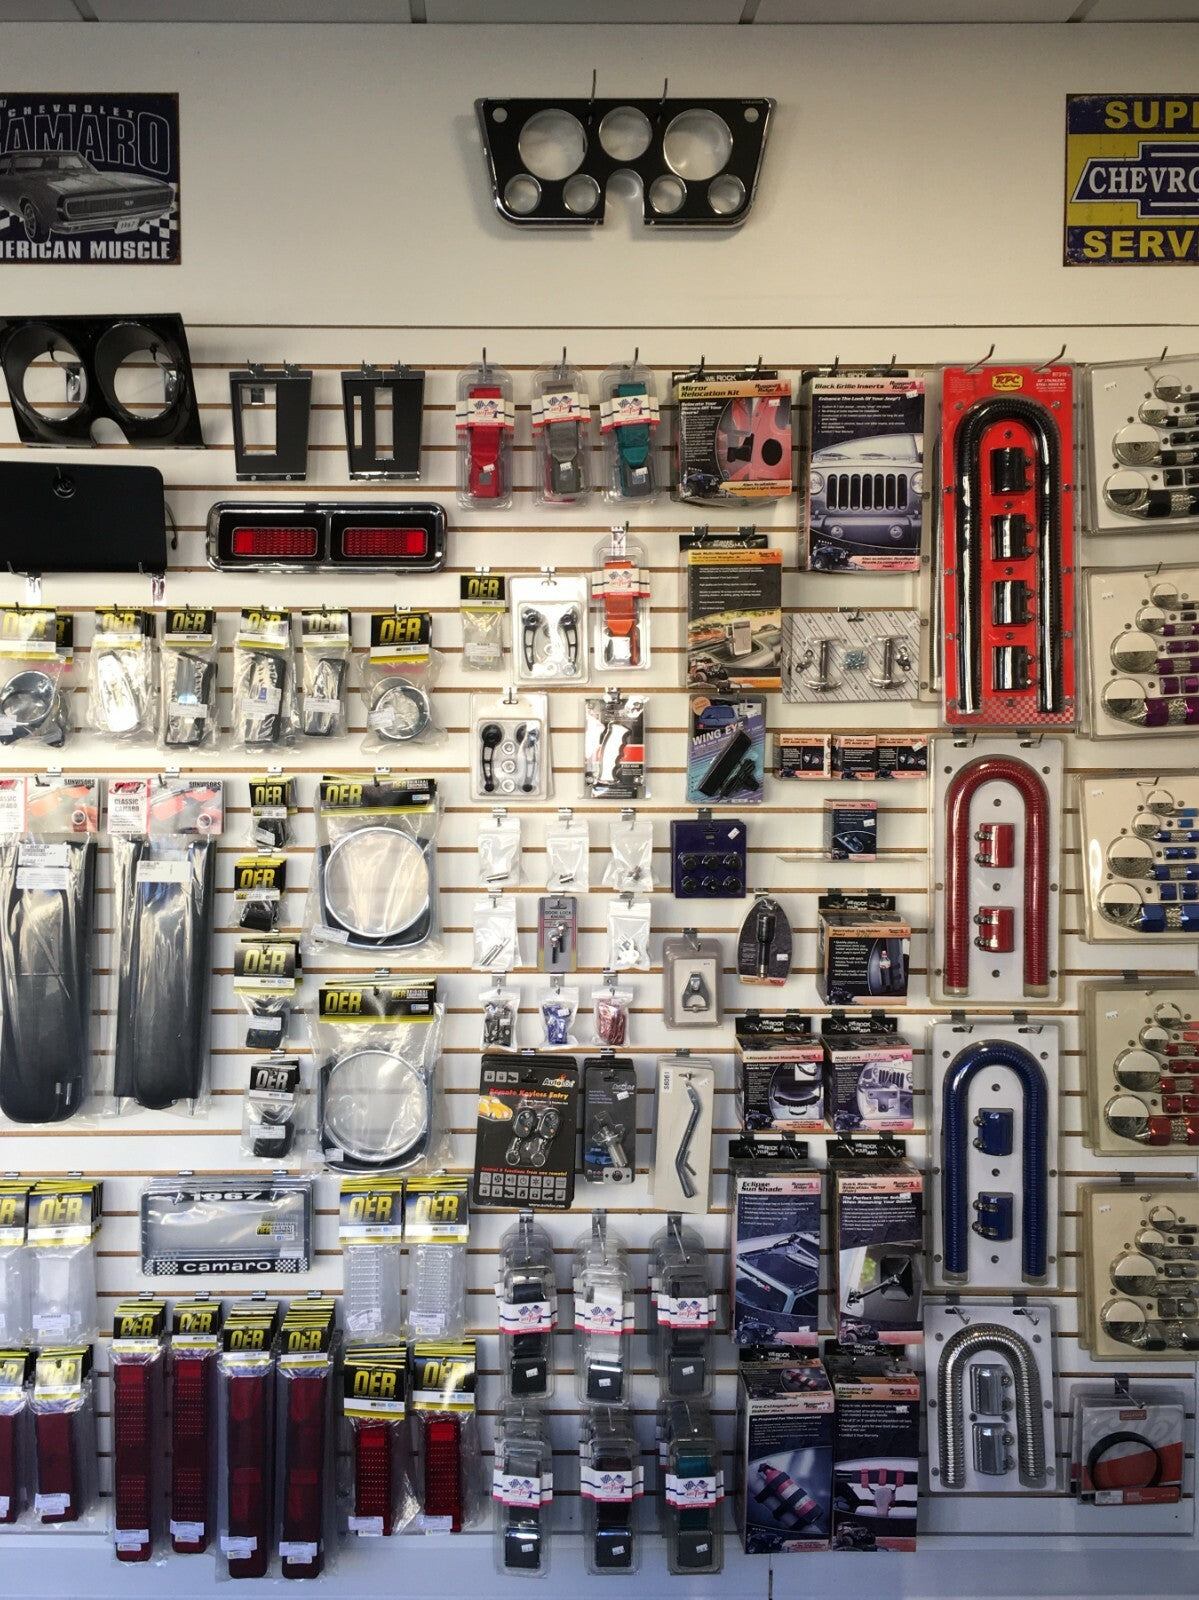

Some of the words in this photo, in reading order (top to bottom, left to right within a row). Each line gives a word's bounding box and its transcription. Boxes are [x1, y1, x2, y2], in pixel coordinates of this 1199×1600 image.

[8, 104, 134, 119] CHEVROLET
[0, 111, 170, 175] AMARO
[0, 240, 81, 259] ERICAN
[90, 241, 170, 259] MUSCLE
[468, 579, 499, 599] OER
[102, 613, 136, 632] OER
[172, 613, 206, 631] OER
[380, 617, 422, 643] OER
[693, 729, 722, 745] WING
[725, 721, 744, 735] EYE
[189, 781, 221, 789] SUNVISORS
[326, 784, 363, 806] OER
[255, 787, 283, 806] OER
[240, 869, 276, 888] OER
[244, 950, 287, 974] OER
[325, 992, 362, 1013] OER
[256, 1070, 288, 1090] OER
[489, 1087, 517, 1096] Remote
[519, 1090, 547, 1098] Keyless
[549, 1091, 569, 1100] Entry
[190, 1192, 262, 1201] 1967
[39, 1197, 83, 1222] OER
[349, 1196, 392, 1221] OER
[416, 1195, 459, 1221] OER
[183, 1261, 271, 1273] camaro
[121, 1316, 154, 1337] OER
[179, 1313, 212, 1333] OER
[231, 1329, 265, 1350] OER
[288, 1330, 322, 1352] OER
[354, 1371, 397, 1397] OER
